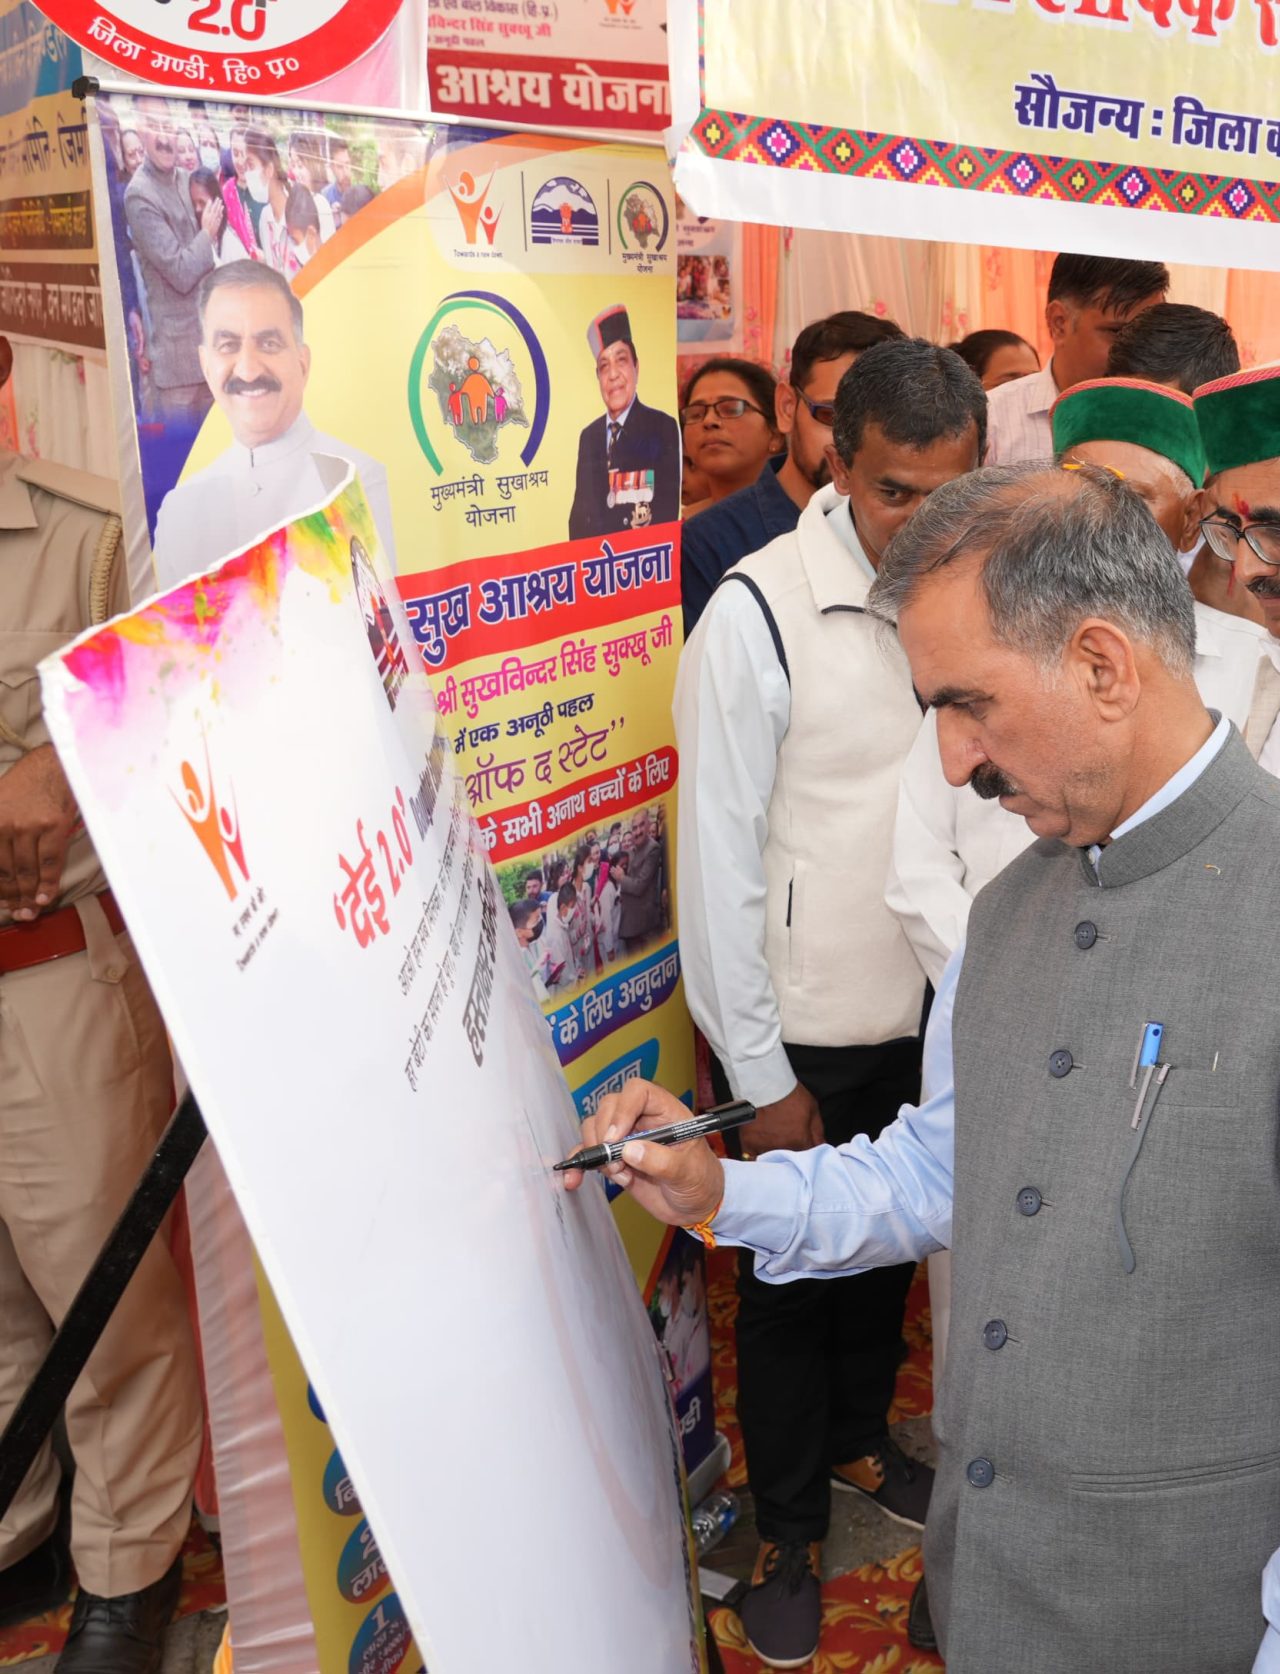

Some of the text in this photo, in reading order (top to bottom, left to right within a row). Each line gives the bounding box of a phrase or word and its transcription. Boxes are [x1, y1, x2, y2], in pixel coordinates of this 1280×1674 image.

[86, 16, 146, 61] जिला
[151, 50, 215, 85] मण्डी,
[188, 0, 266, 41] 2.0
[435, 62, 673, 115] आश्रय योजना
[1014, 73, 1145, 139] सौजन्य
[1172, 95, 1263, 154] जिला
[431, 470, 549, 510] मुख्यमंत्री सुखाश्रय
[465, 504, 516, 528] योजना
[405, 540, 673, 666] सुख आश्रय योजना
[435, 613, 673, 719] श्री सुखविन्दर सिंह सुक्खू जी
[455, 693, 595, 755] में एक अनूठी पहल
[465, 752, 525, 808] ऑफ
[534, 750, 553, 784] द
[502, 801, 544, 845] सभी
[547, 789, 586, 831] अनाथ
[587, 767, 628, 808] बच्चों
[627, 762, 644, 794] के
[644, 754, 670, 788] लिए
[558, 1003, 579, 1045] के
[582, 989, 614, 1033] लिए
[618, 952, 679, 1012] अनुदान
